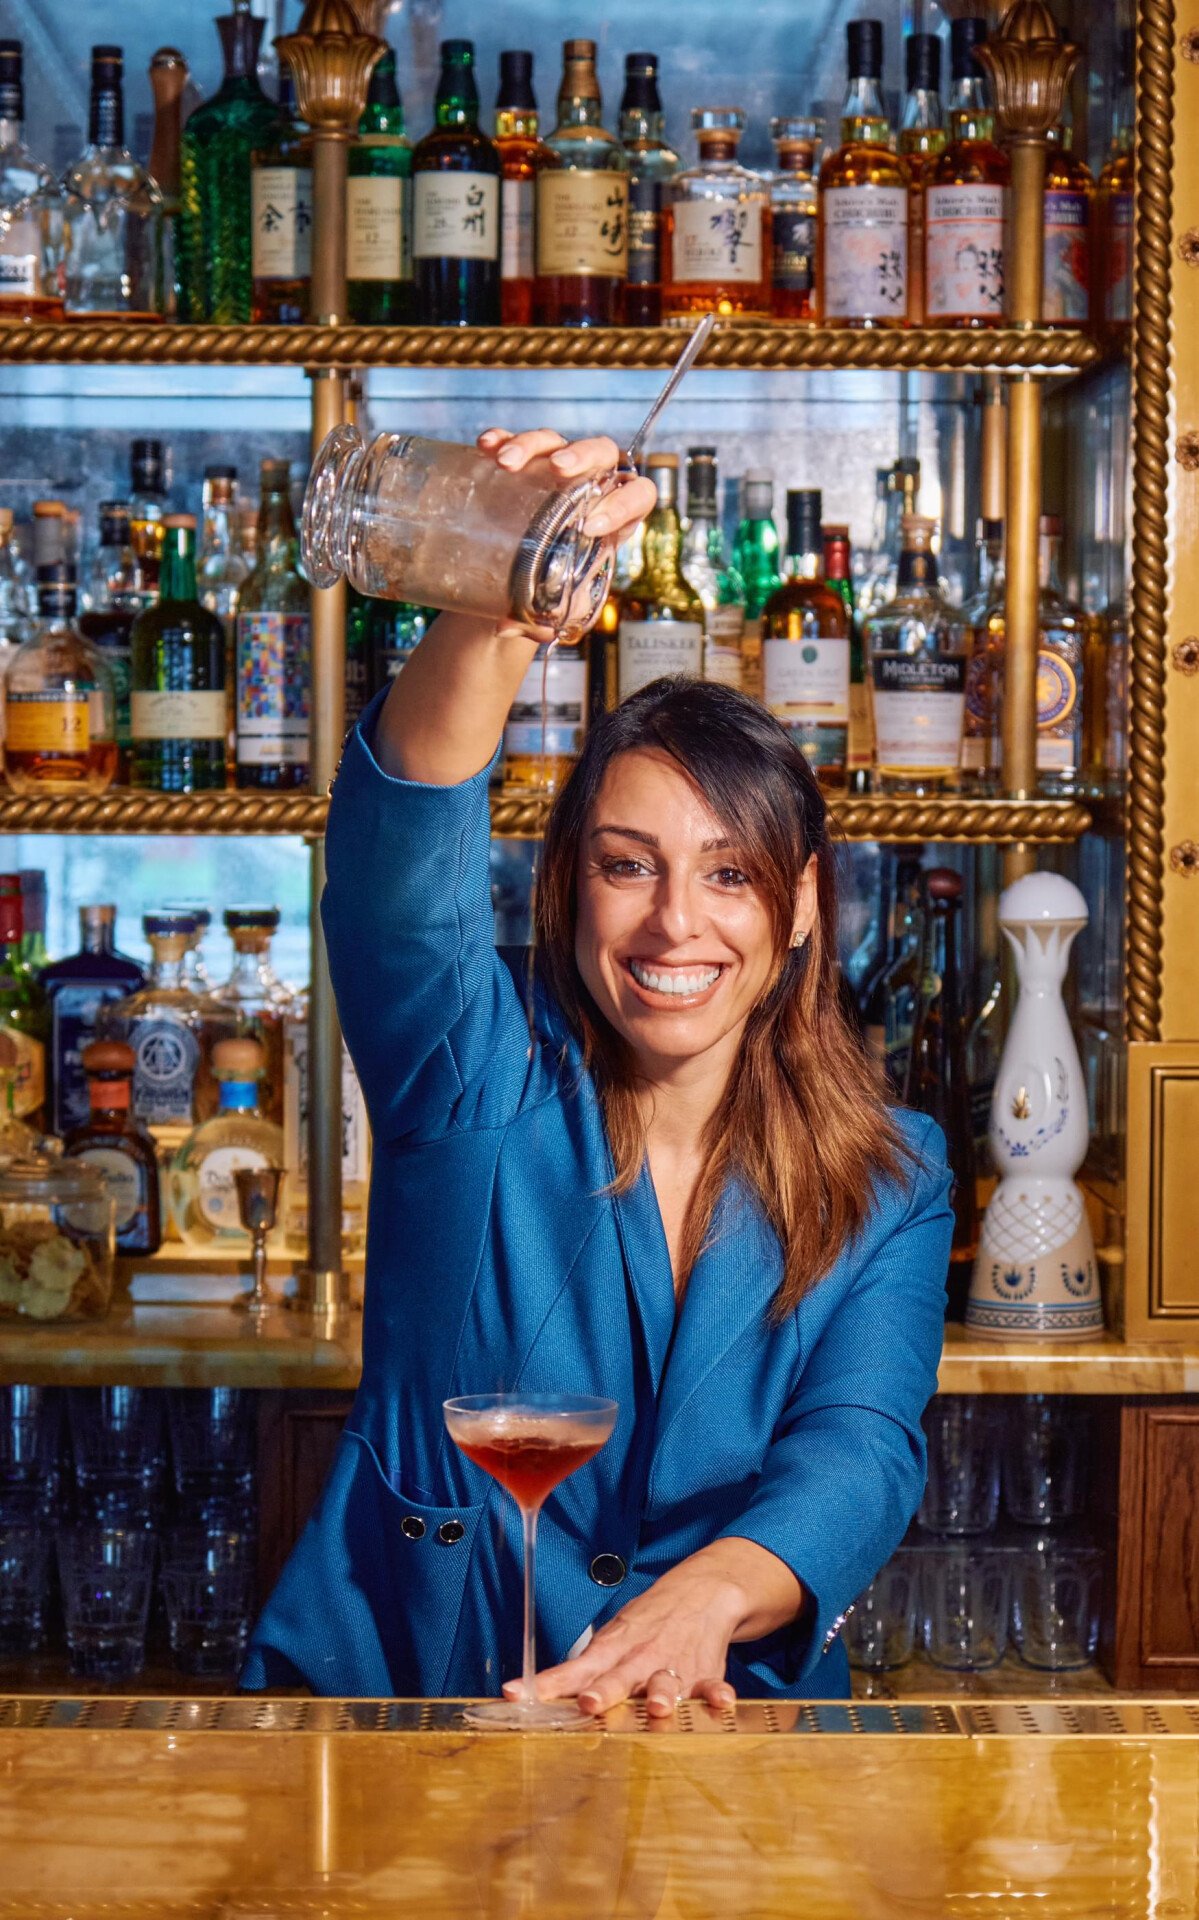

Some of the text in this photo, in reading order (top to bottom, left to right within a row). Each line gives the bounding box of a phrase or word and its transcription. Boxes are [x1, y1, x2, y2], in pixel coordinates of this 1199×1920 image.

[462, 184, 486, 237] 白州
[627, 636, 696, 649] TALISKER
[882, 660, 960, 678] MIDLETON
[62, 716, 82, 732] 12
